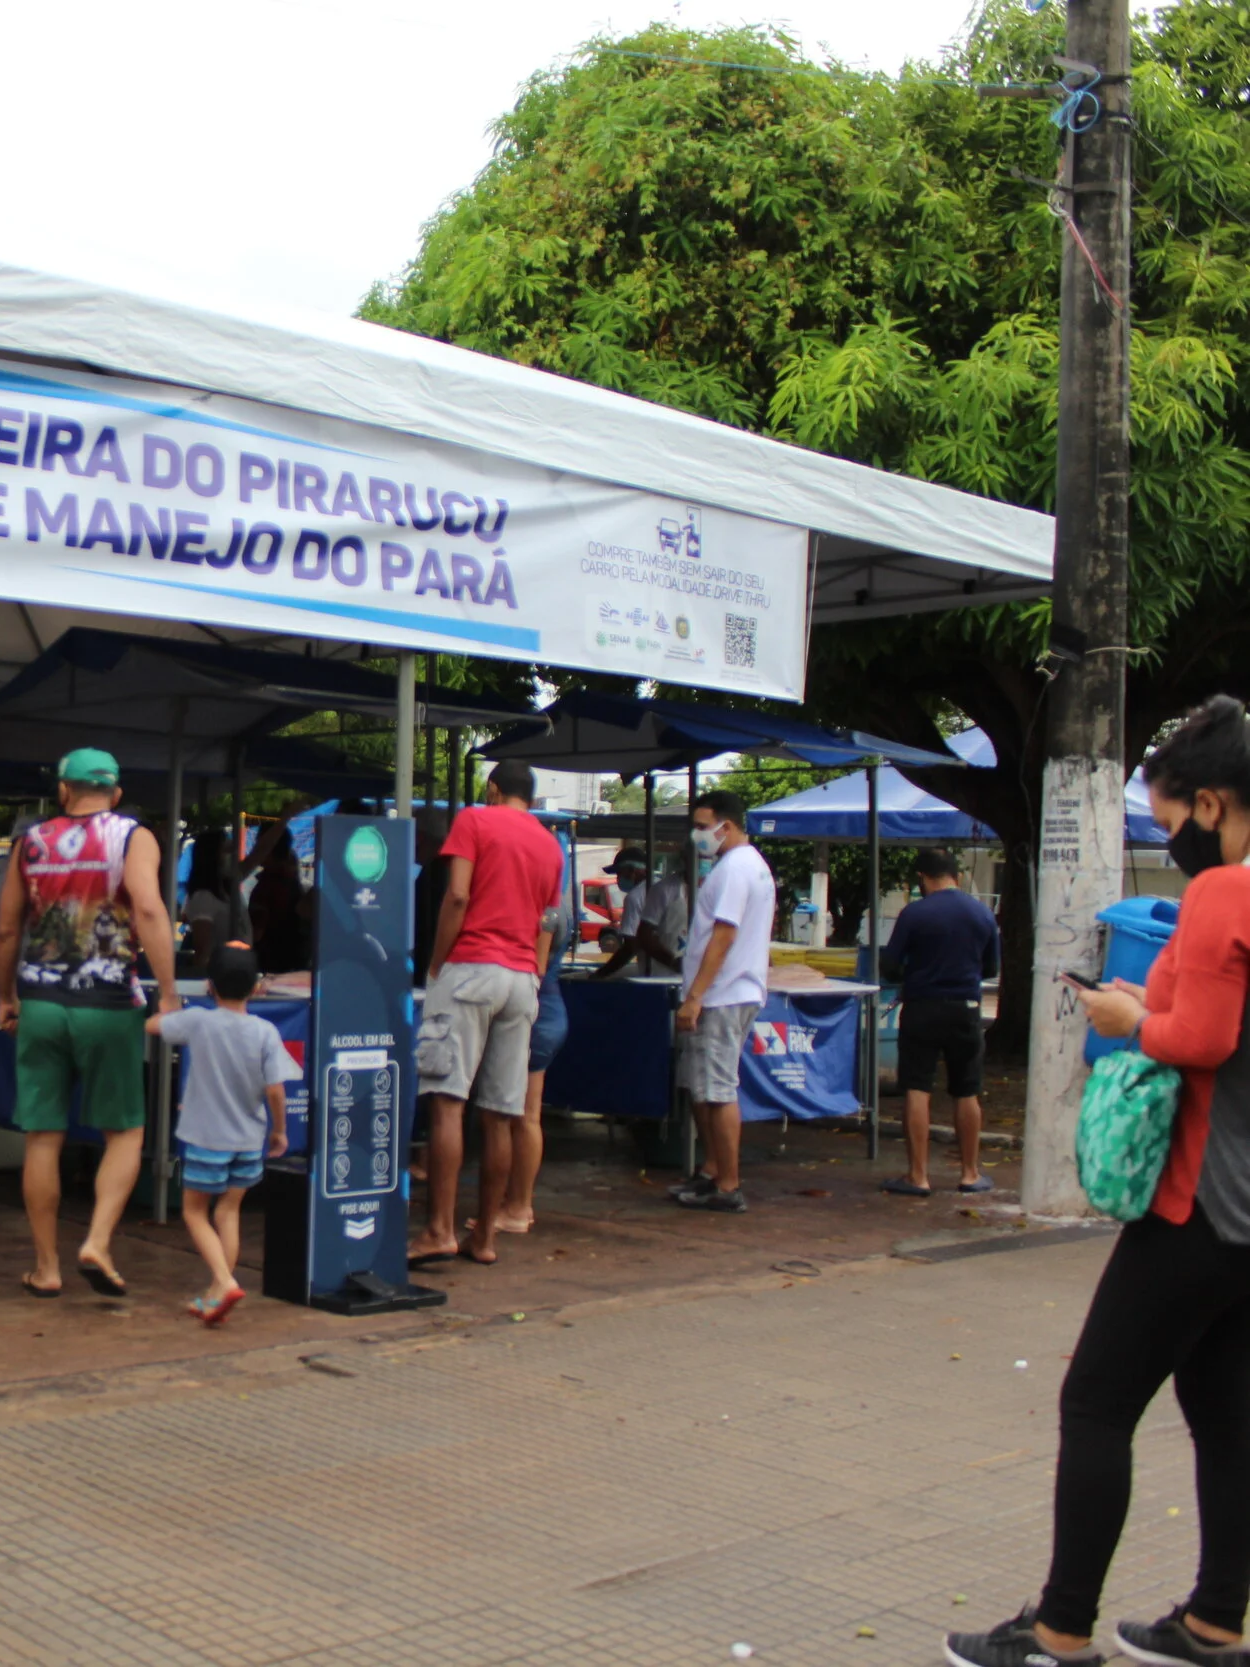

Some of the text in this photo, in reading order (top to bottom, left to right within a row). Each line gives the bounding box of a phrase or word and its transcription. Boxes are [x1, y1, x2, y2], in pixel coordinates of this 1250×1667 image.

[141, 434, 226, 498] DO
[238, 450, 510, 544] PIRARUCU
[24, 486, 286, 576] MANEJO
[291, 529, 368, 588] DO
[380, 542, 519, 610] PARÁ
[587, 540, 635, 564] COMPRE
[678, 560, 702, 577] SEM
[703, 564, 727, 583] SAIR
[728, 569, 743, 586] DO
[744, 573, 765, 590] SEU
[580, 558, 771, 609] CARRO PELA MODALIDADE DRIVE THRU
[331, 1032, 396, 1049] ÁLCOOL EM GEL
